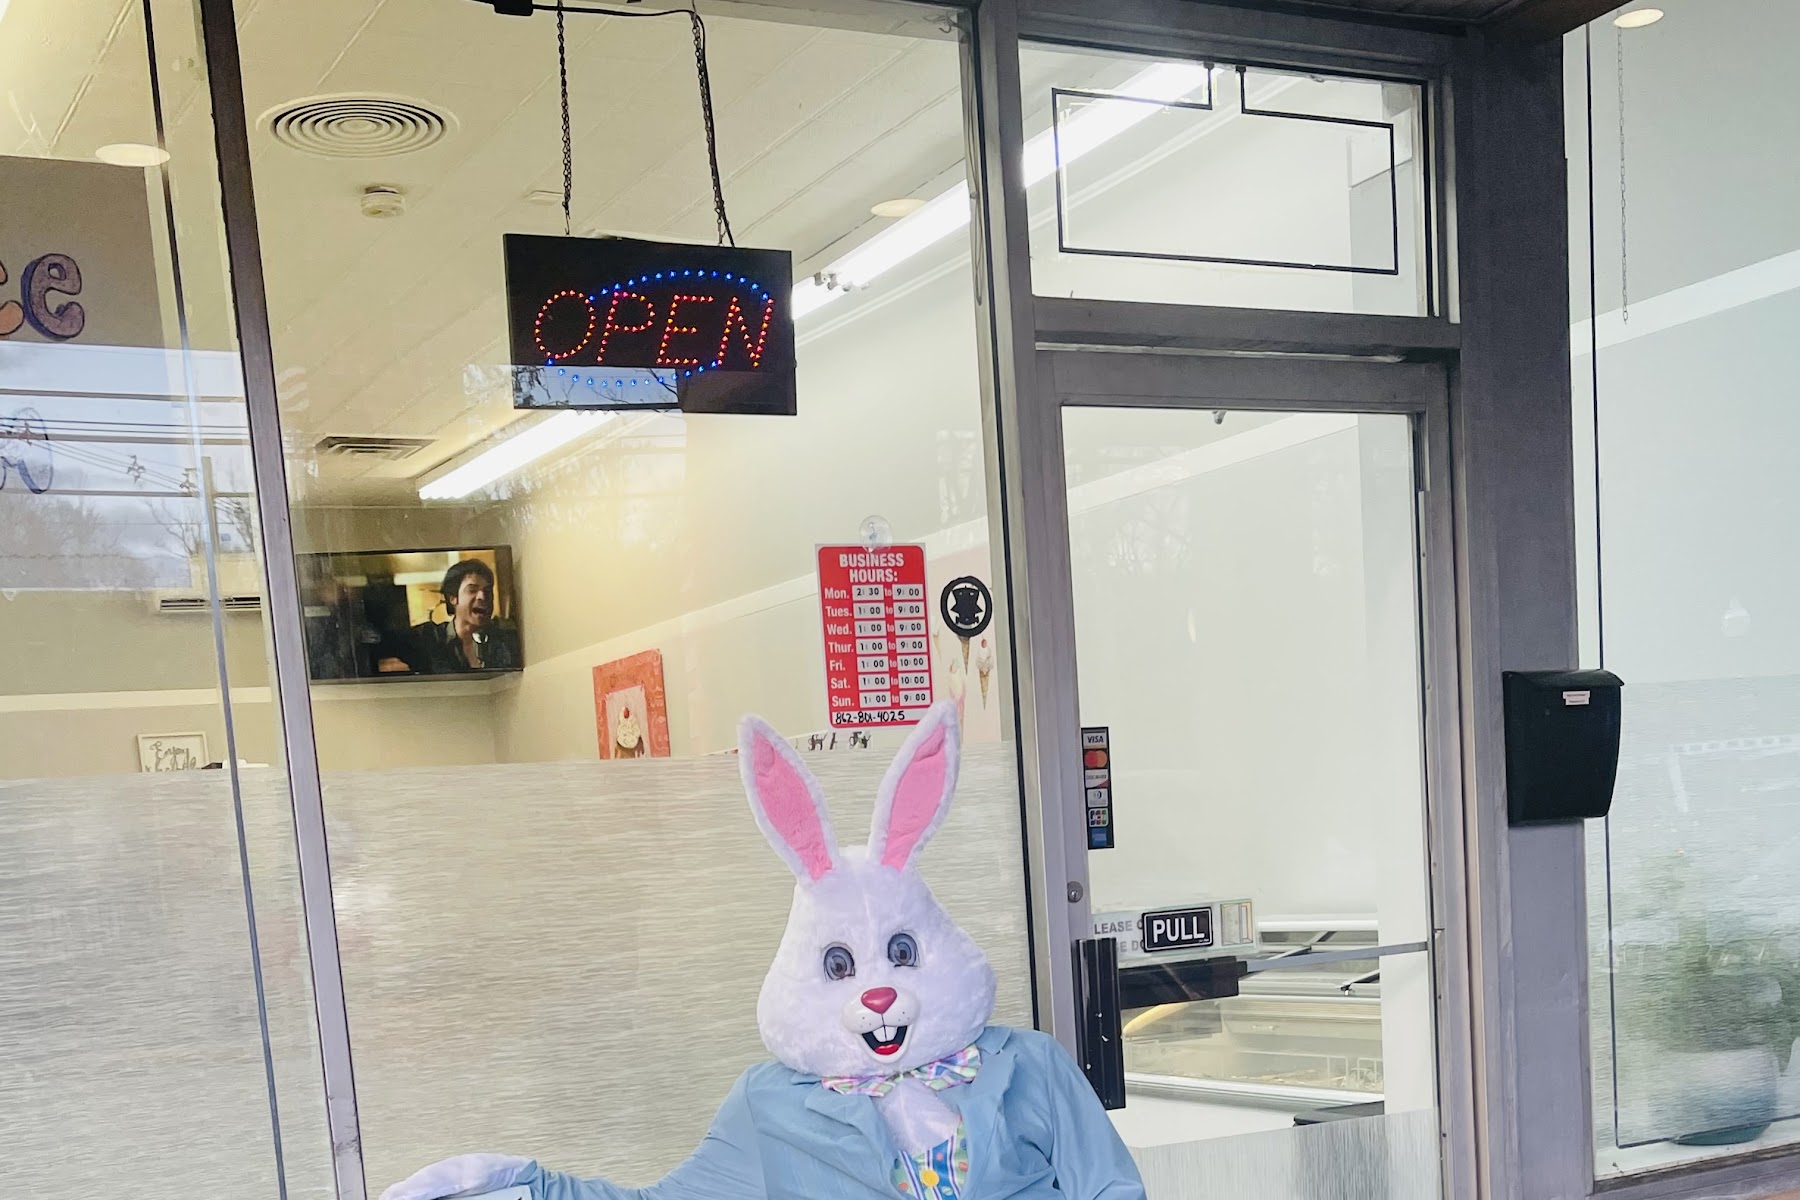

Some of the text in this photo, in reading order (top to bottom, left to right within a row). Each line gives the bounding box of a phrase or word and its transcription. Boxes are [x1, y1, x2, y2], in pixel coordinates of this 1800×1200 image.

[533, 288, 776, 367] OPEN
[839, 553, 904, 568] BUSINESS
[849, 568, 898, 583] HOURS:
[824, 587, 850, 599] Mon.
[884, 588, 892, 597] to
[825, 605, 852, 617] Tues.
[885, 605, 893, 614] to
[826, 623, 852, 635] Wed.
[887, 623, 895, 632] to
[828, 641, 854, 653] Thur.
[888, 641, 896, 650] to
[829, 659, 846, 671] Fri.
[889, 659, 897, 668] to
[830, 677, 851, 689] Sat.
[890, 677, 898, 685] to
[832, 695, 855, 707] Sun.
[892, 695, 900, 703] to
[1087, 735, 1104, 743] VISA
[1094, 920, 1133, 935] LEASE
[1152, 916, 1205, 943] PULL
